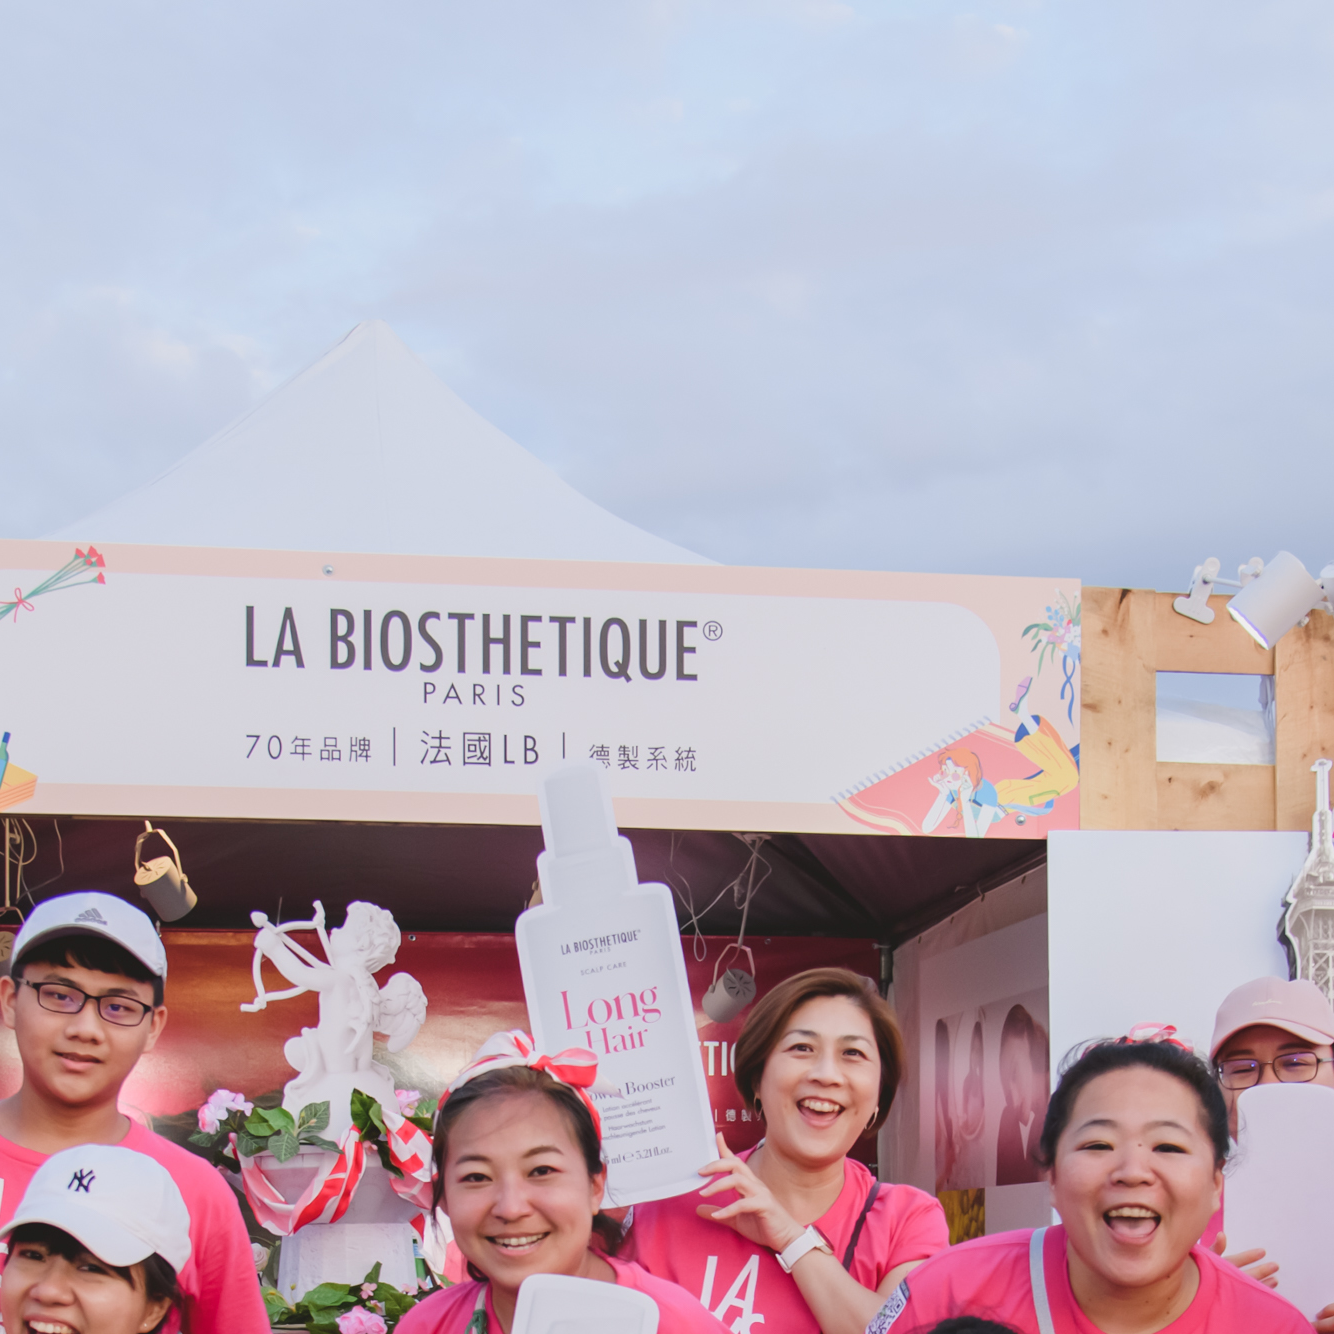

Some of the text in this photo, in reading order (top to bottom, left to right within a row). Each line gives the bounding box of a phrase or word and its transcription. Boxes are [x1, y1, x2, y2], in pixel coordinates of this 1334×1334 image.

[245, 605, 305, 669] LA
[423, 682, 526, 706] PARIS
[245, 730, 697, 772] 70年品牌 法國LB 德製系統
[561, 943, 572, 956] LA
[580, 961, 627, 976] SCALP CARE
[561, 985, 662, 1032] Long
[585, 1025, 649, 1055] Hair
[625, 1076, 676, 1096] Booster
